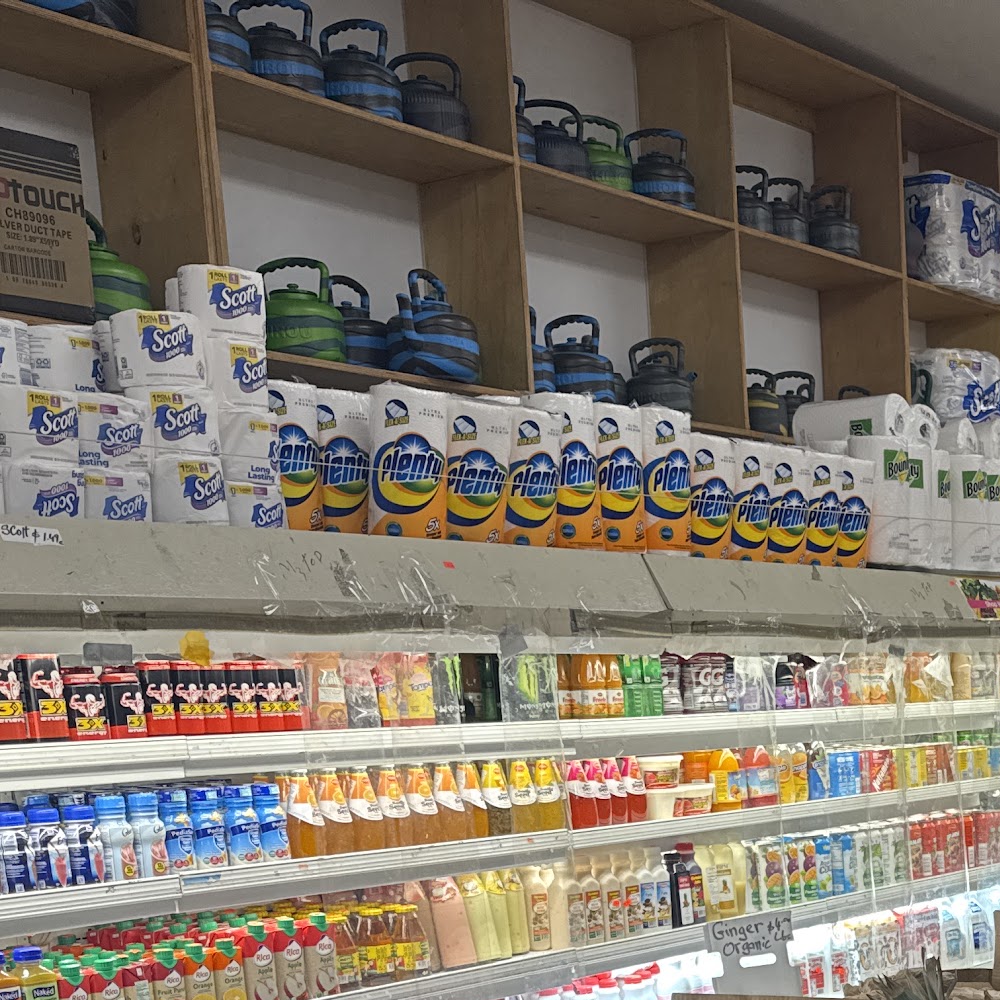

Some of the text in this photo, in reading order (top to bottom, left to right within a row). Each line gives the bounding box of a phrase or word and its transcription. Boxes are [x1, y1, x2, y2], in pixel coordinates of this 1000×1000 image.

[5, 206, 56, 226] CH89096
[6, 231, 22, 242] SIZE:
[24, 223, 72, 240] DUCT TAPE
[220, 285, 256, 310] Scott
[232, 305, 248, 316] 1000
[152, 325, 188, 353] Scott
[42, 408, 78, 435] Scott
[164, 405, 200, 431] Scott
[105, 423, 141, 445] Scott
[250, 465, 271, 475] Long
[381, 446, 446, 483] Plenty
[248, 472, 275, 483] Lasting
[448, 460, 508, 497] Plenty
[110, 497, 144, 519] Scott
[77, 719, 104, 732] 3X
[712, 921, 763, 941] Ginger
[286, 946, 300, 958] Rico
[318, 941, 333, 952] Rico
[723, 936, 772, 957] Organic
[255, 950, 271, 963] Rico
[320, 956, 334, 965] Apple
[227, 963, 240, 973] Rico
[257, 966, 274, 976] Apple
[288, 961, 302, 970] Apple
[166, 974, 181, 985] Rico
[195, 969, 209, 979] Rico
[193, 981, 213, 991] Orange
[225, 975, 244, 986] Orange
[33, 986, 55, 998] Naked
[104, 987, 119, 998] Rico
[157, 988, 173, 997] Fruit
